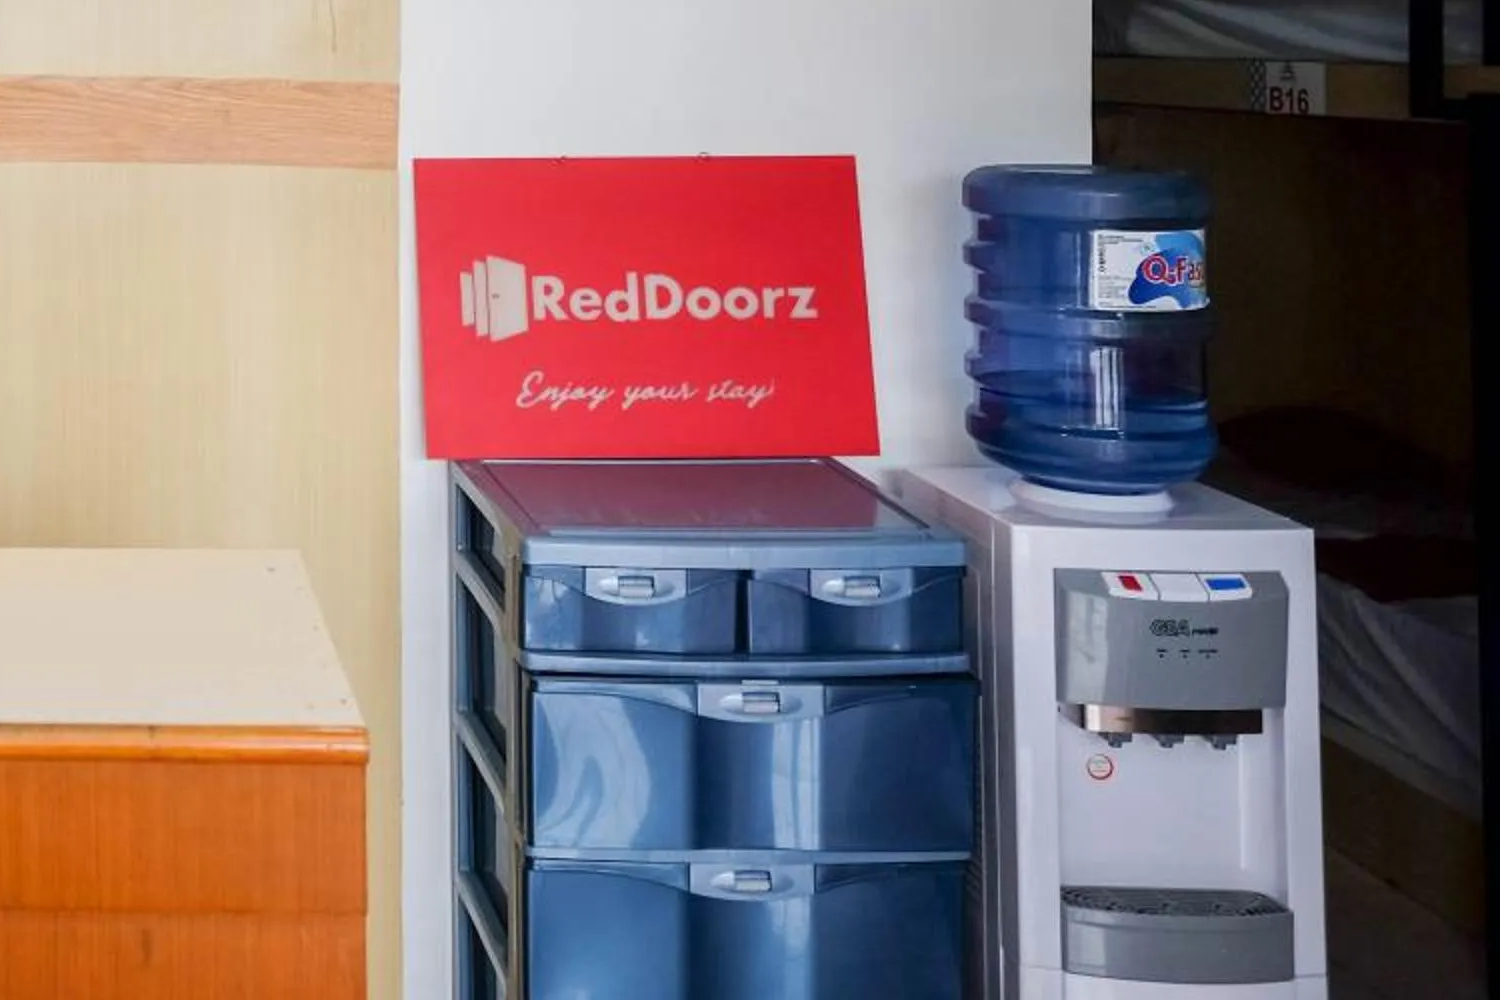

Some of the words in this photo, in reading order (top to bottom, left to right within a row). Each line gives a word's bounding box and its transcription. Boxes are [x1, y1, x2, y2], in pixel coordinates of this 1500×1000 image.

[1268, 85, 1309, 114] B16
[531, 271, 818, 322] RedDoorz
[516, 370, 615, 411] Enjoy
[622, 381, 699, 411] your
[707, 377, 775, 409] stay
